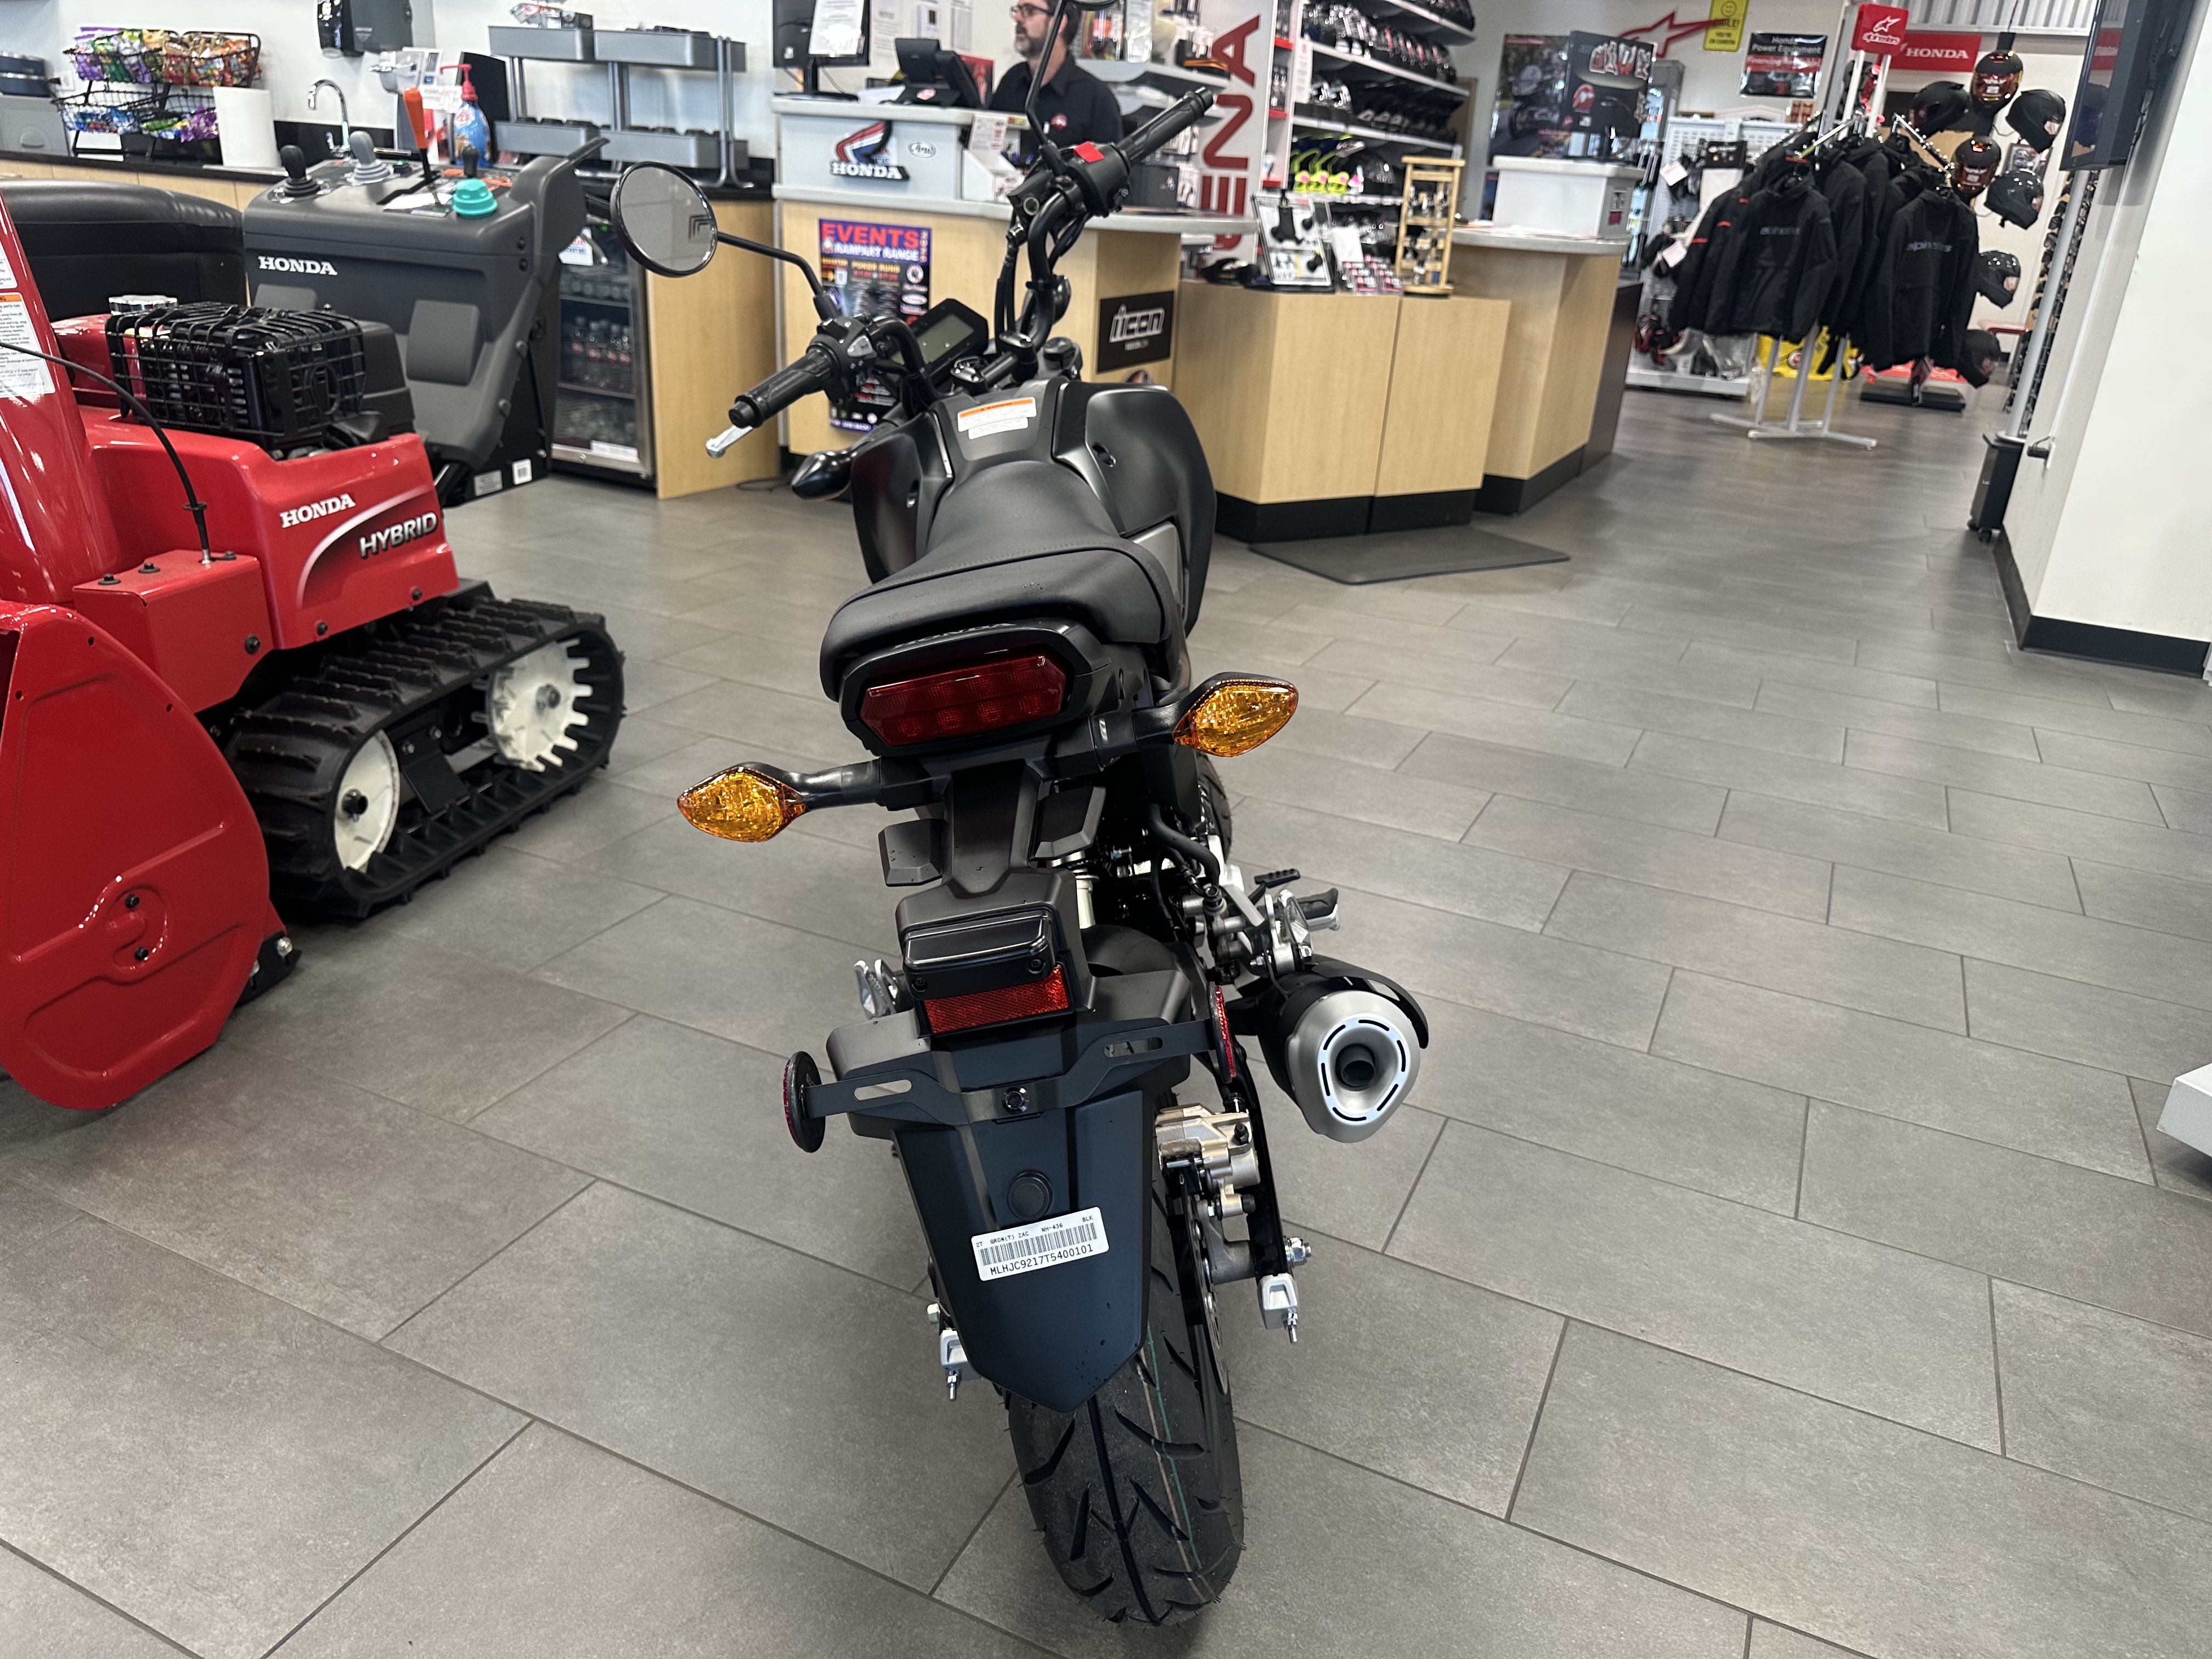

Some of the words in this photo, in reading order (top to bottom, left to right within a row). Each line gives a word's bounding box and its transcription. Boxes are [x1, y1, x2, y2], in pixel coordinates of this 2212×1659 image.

[1906, 47, 1969, 59] HONDA
[832, 162, 902, 180] HONDA
[822, 223, 919, 249] EVENTS
[258, 256, 338, 275] HONDA
[280, 493, 356, 528] HONDA
[358, 511, 438, 558] HYBRID
[990, 1244, 1093, 1276] MLHJC9217T5400101
